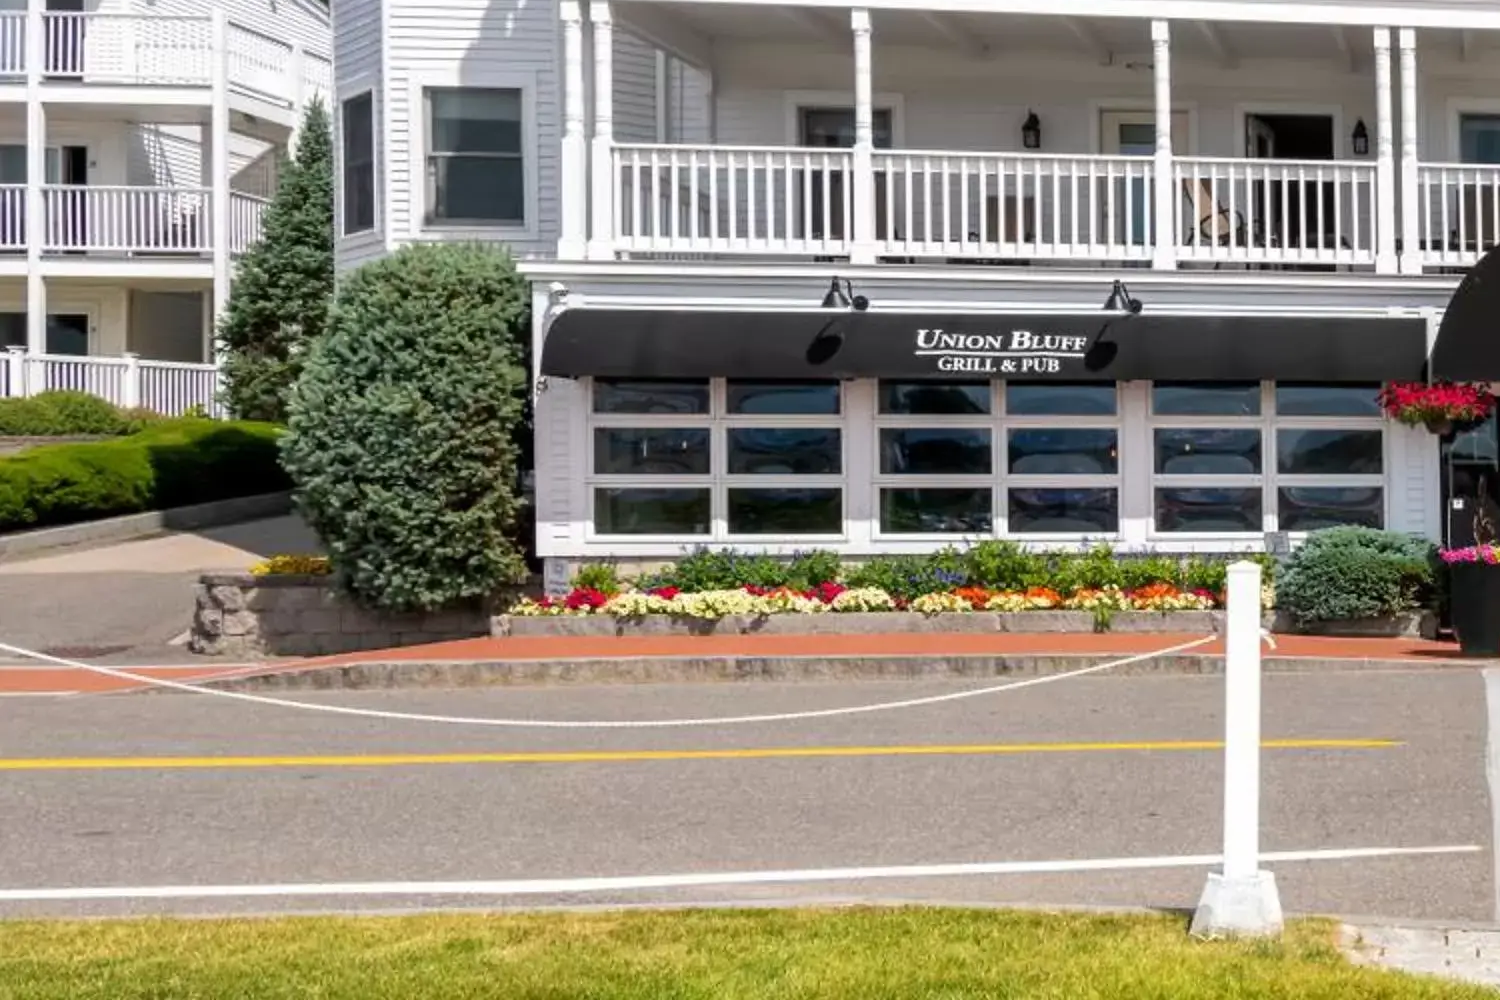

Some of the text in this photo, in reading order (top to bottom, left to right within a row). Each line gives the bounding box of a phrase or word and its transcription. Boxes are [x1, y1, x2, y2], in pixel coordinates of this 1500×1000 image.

[915, 329, 1087, 350] UNION BLUFF
[938, 356, 1060, 373] GRILL & PUB
